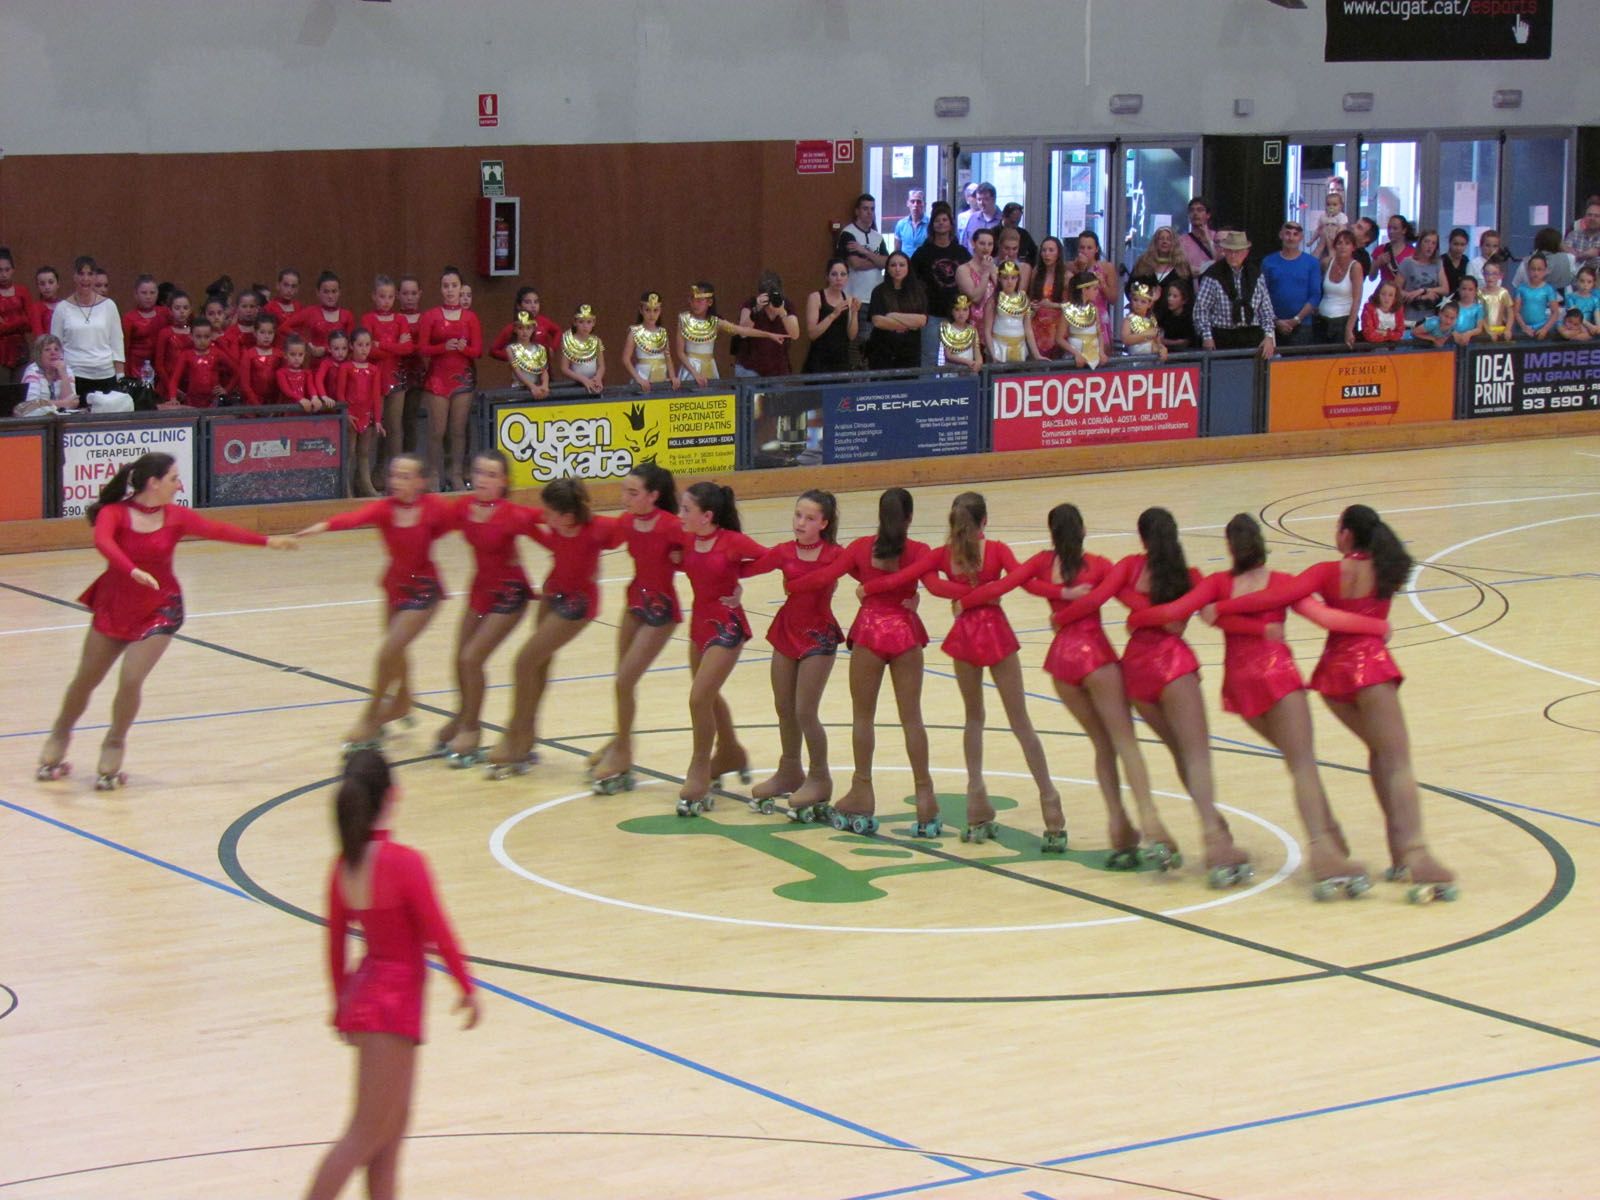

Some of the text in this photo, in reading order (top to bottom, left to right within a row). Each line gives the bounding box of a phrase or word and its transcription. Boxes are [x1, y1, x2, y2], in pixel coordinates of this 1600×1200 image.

[1343, 0, 1538, 20] www.cugat.cat/esports
[1338, 365, 1387, 376] PREMIUM
[1476, 353, 1514, 383] IDEA
[1523, 372, 1544, 383] EN
[1545, 370, 1581, 382] GRAN
[993, 371, 1198, 420] IDEOGRAPHIA
[1343, 386, 1378, 398] SAULA
[1474, 382, 1515, 406] PRINT
[1522, 386, 1552, 395] LONES
[1558, 384, 1585, 393] VINILS
[669, 400, 728, 412] ESPECIALISTES
[856, 397, 970, 412] DR. ECHEVARNE
[1522, 394, 1600, 410] 93 590 1
[669, 411, 725, 423] EN PATINATGE
[1041, 418, 1078, 429] BARCELONA
[1087, 415, 1114, 425] CORUÑA
[1117, 415, 1137, 423] AOSTA
[1140, 412, 1168, 421] ORLANDO
[673, 421, 703, 432] HOQUEI
[704, 420, 732, 431] PATINS
[140, 429, 187, 443] CLINIC
[500, 412, 612, 462] Queen
[698, 436, 718, 444] SKATER
[75, 458, 127, 481] INFÀ
[531, 444, 633, 482] Skate
